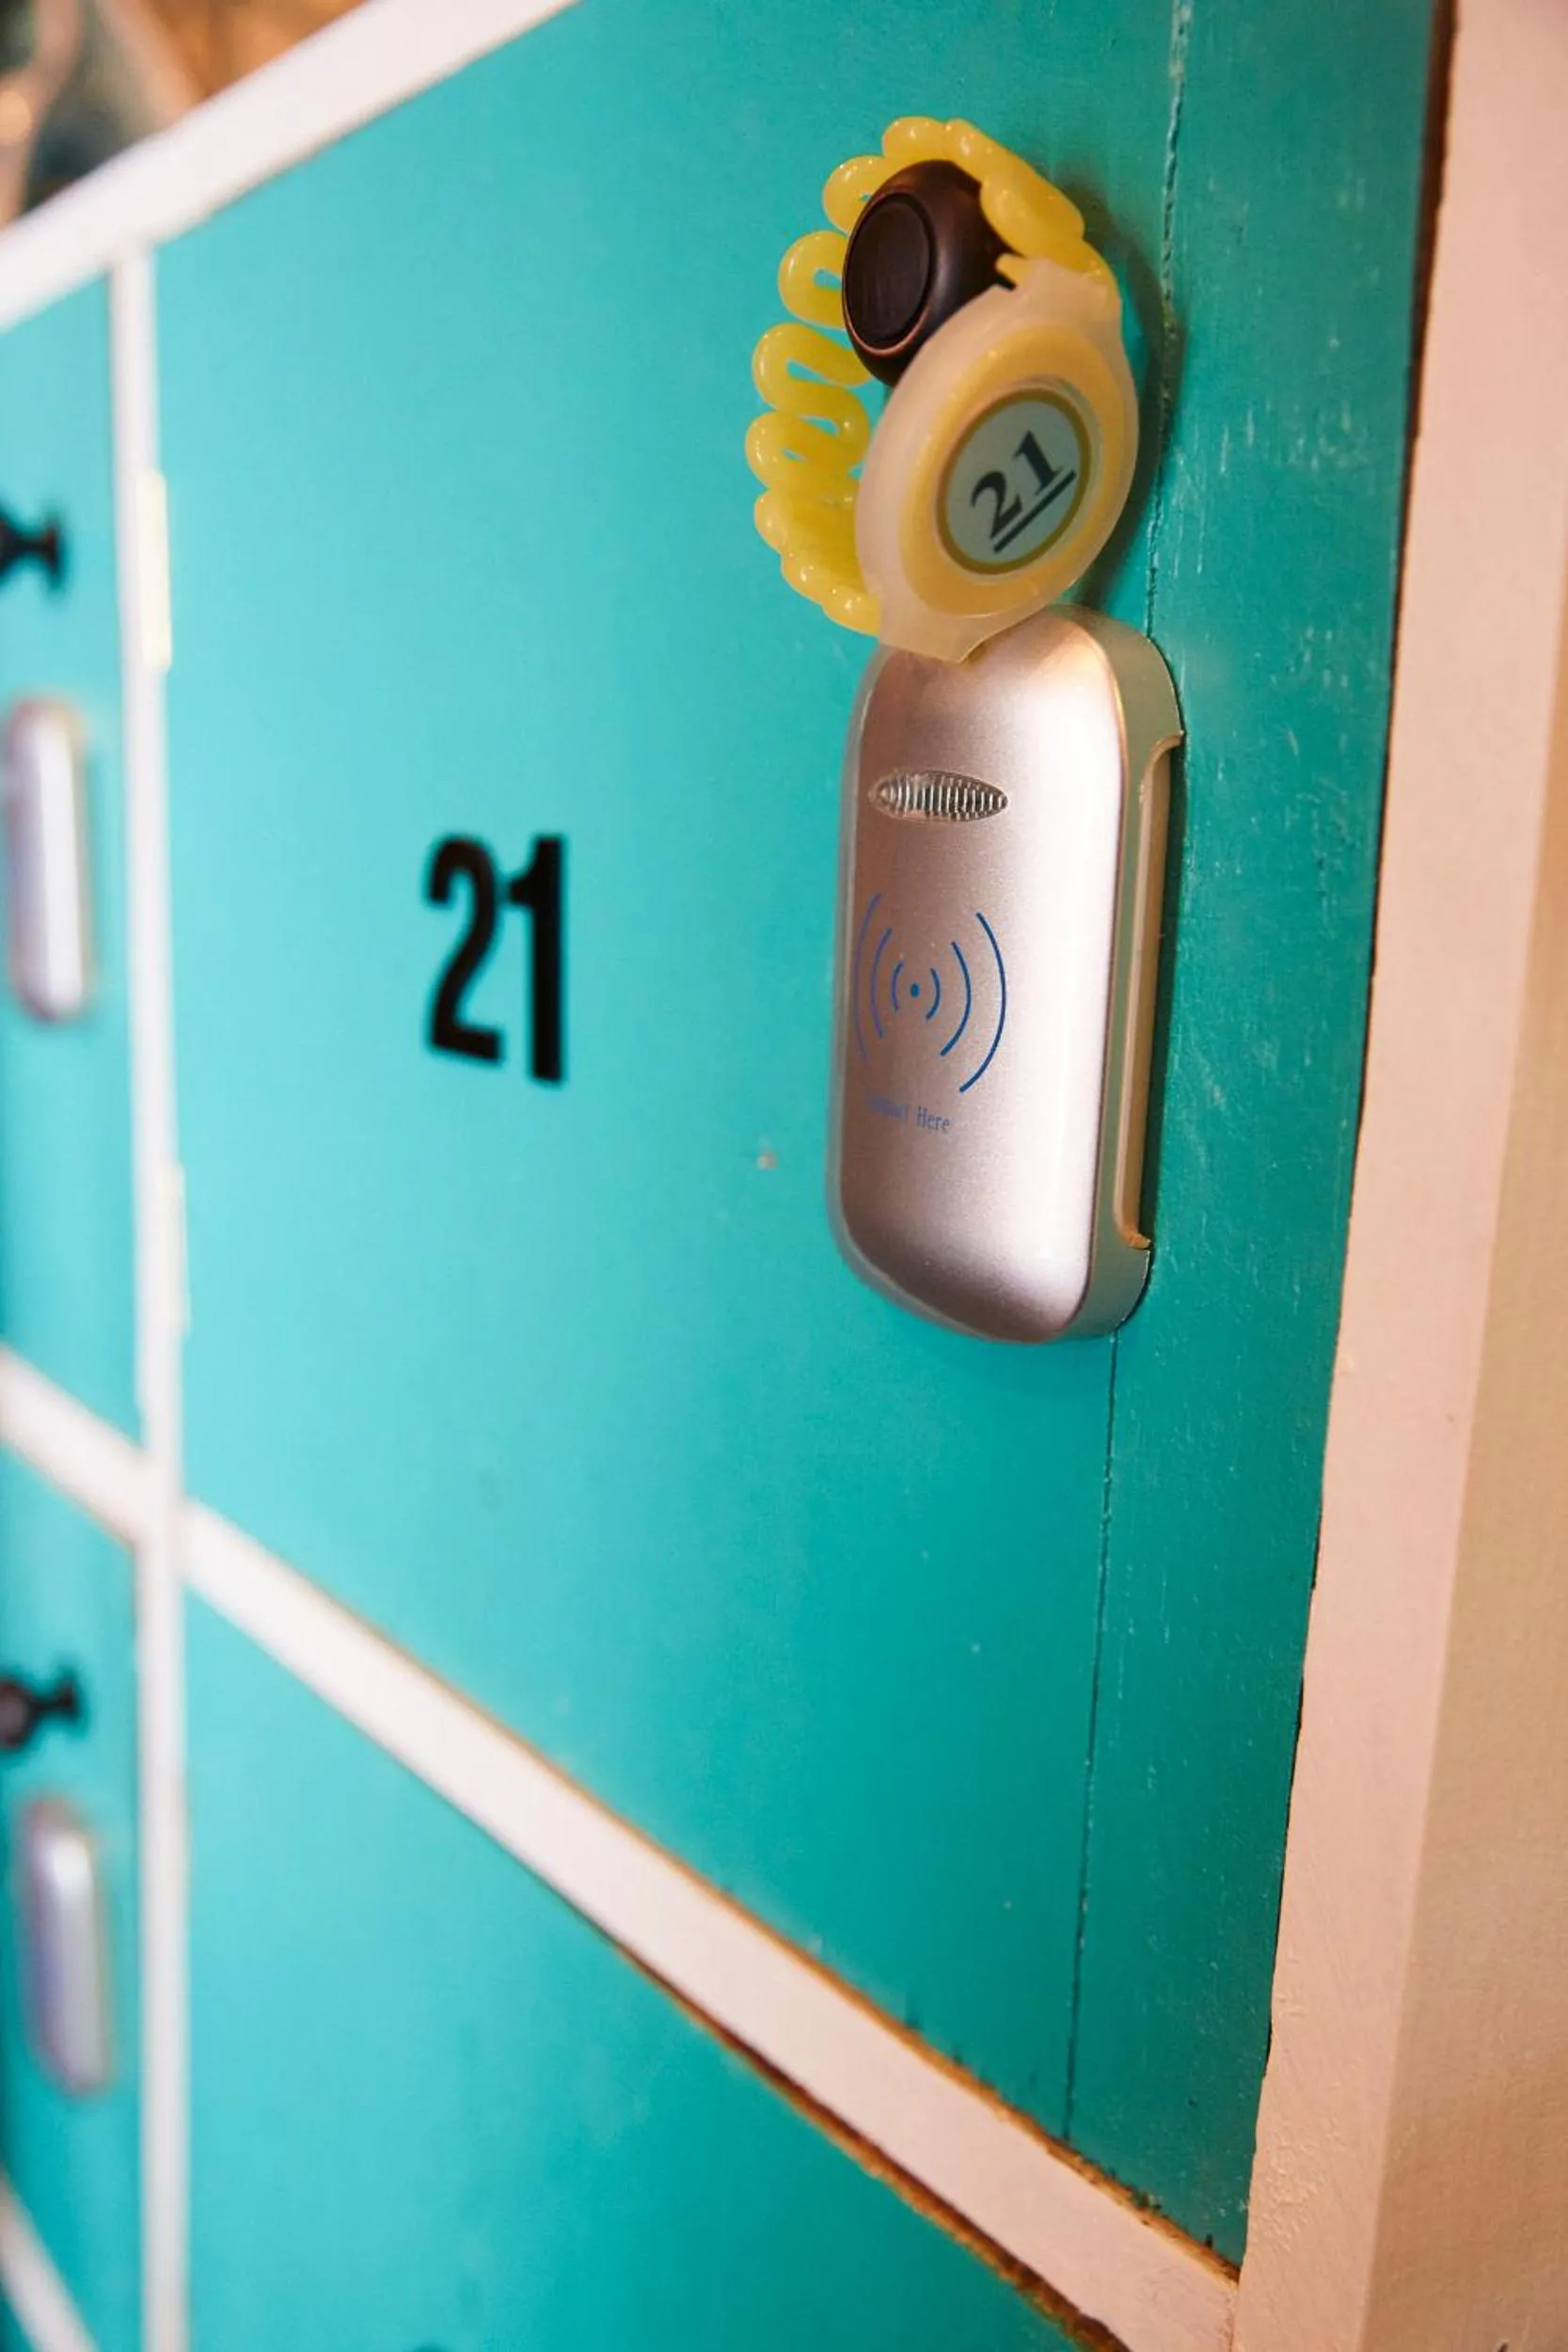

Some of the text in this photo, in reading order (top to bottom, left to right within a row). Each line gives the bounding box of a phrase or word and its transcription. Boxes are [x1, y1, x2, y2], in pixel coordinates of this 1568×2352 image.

[970, 429, 1065, 539] 21
[424, 833, 568, 1088] 21
[917, 1105, 950, 1132] Here
